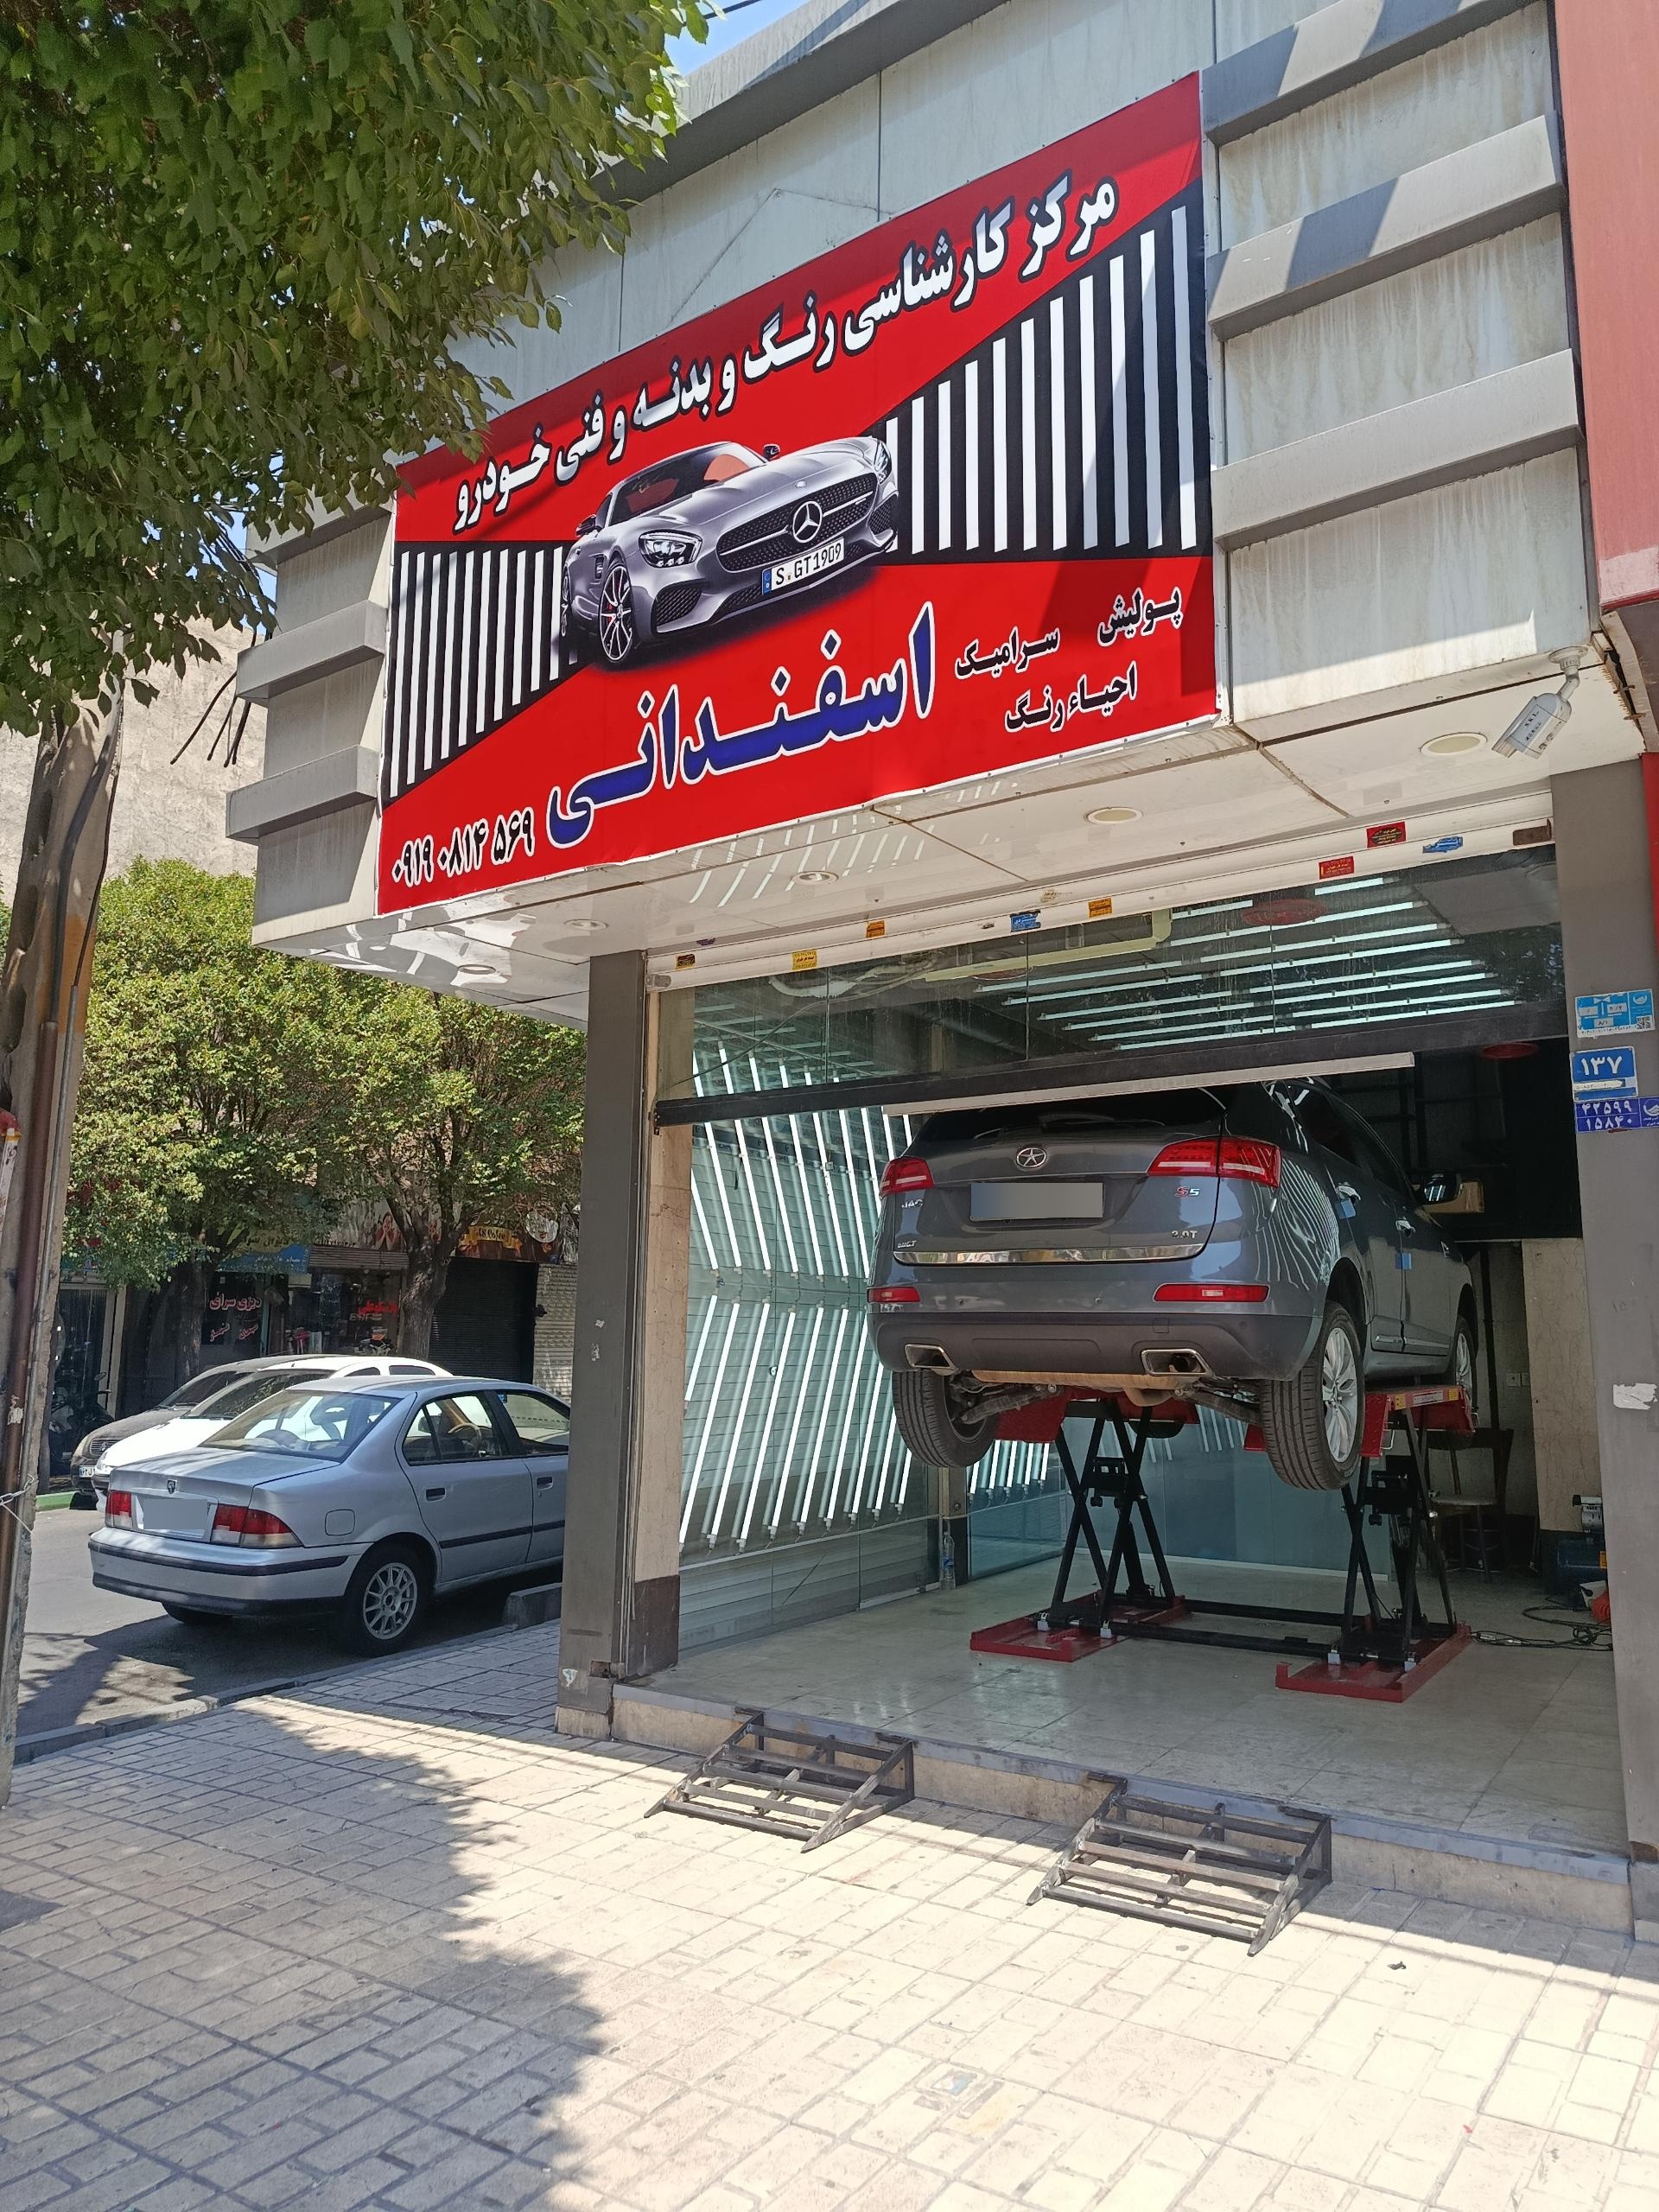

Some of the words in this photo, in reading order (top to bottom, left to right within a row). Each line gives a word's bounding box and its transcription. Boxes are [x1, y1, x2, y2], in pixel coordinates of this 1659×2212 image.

[1020, 170, 1120, 282] مرکز
[842, 196, 1015, 357] کارشناسی
[741, 290, 838, 384] رنگ
[631, 355, 714, 430] بدنه
[715, 356, 739, 416] و
[554, 388, 606, 485] فنی
[607, 406, 628, 465] و
[452, 423, 553, 534] خودرو
[1097, 587, 1183, 646] پولیش
[955, 626, 1061, 679] سرامیک
[1004, 684, 1065, 733] رنگ
[1067, 660, 1138, 721] احیاء
[547, 601, 936, 849] اسفندانی
[392, 835, 434, 887] ۰۹۱۹
[437, 818, 489, 878] ۰۸۱۴
[491, 807, 535, 866] ۵۶۹
[1581, 1056, 1623, 1076] ۱۳۷
[1581, 1100, 1632, 1116] ۴۲۵۹۹
[1586, 1116, 1632, 1131] ۱۵۸۴۰
[901, 1198, 924, 1209] JAC
[1174, 1185, 1200, 1198] S5
[1171, 1230, 1198, 1239] 2.0T
